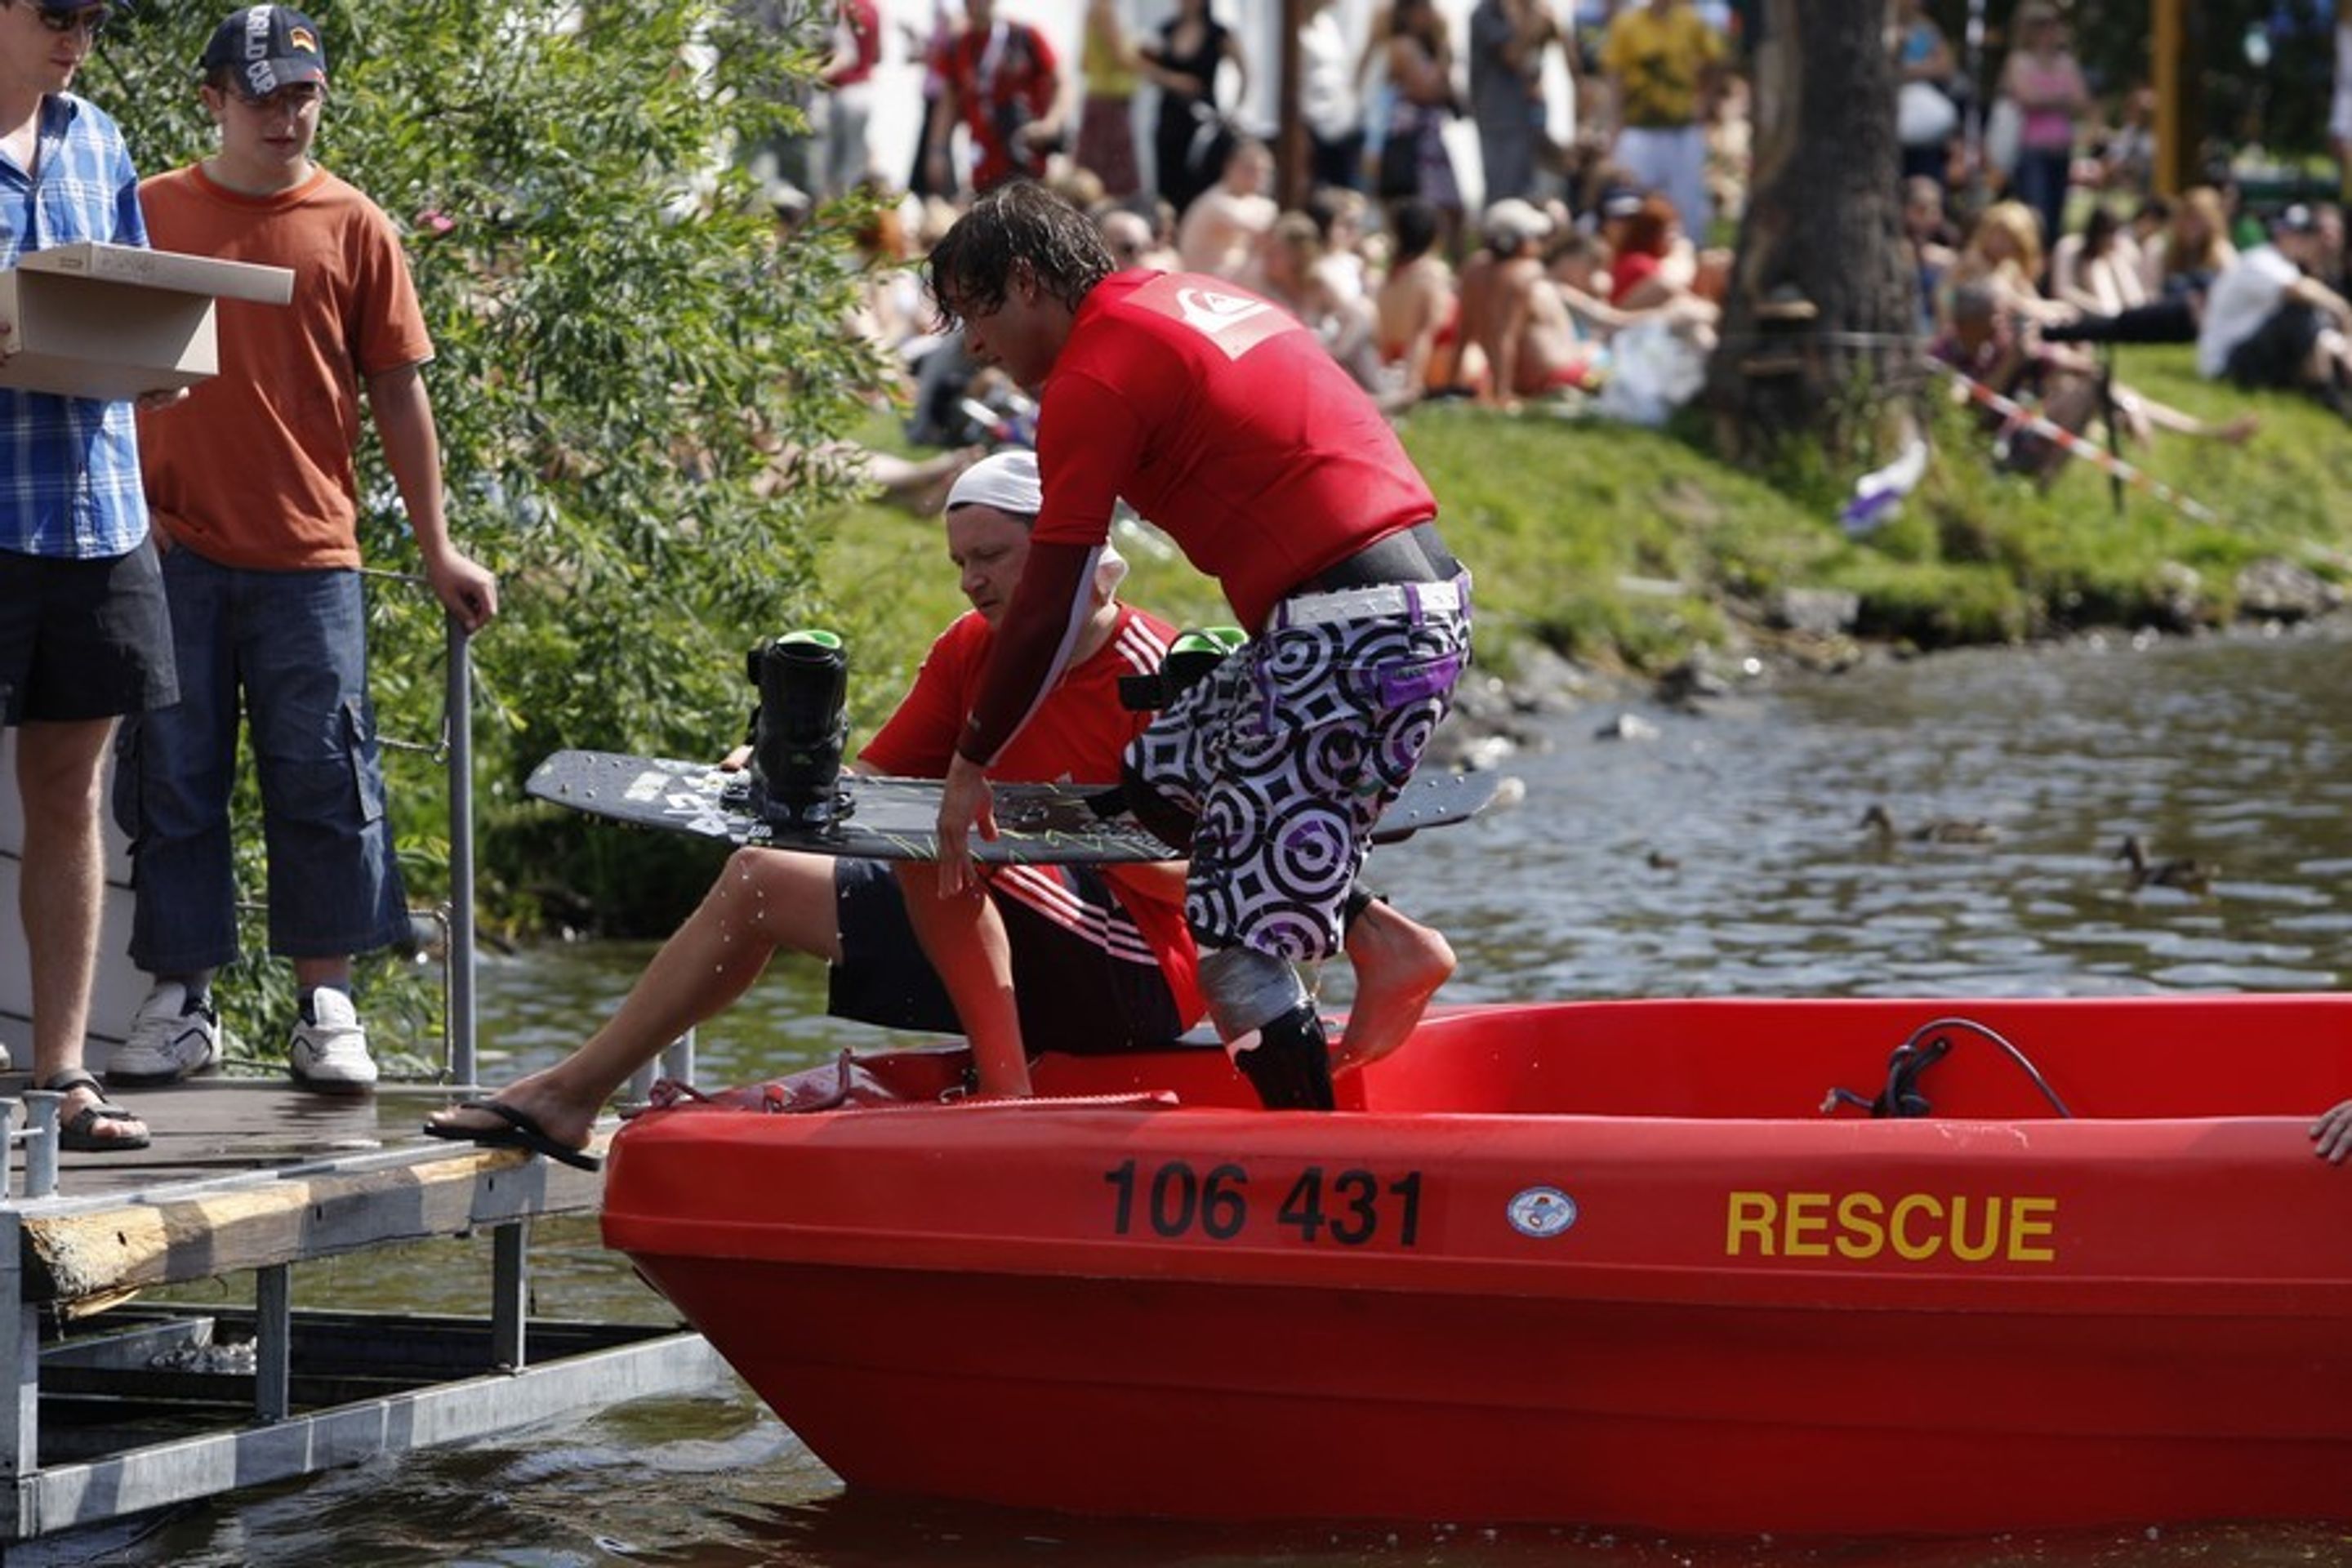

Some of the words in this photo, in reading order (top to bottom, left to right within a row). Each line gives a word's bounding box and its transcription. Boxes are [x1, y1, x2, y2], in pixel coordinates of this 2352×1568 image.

[246, 5, 274, 60] ORLD
[247, 60, 277, 96] CUP
[1105, 1159, 1248, 1241] 106
[1277, 1167, 1423, 1246] 431
[1726, 1192, 2057, 1262] RESCUE
